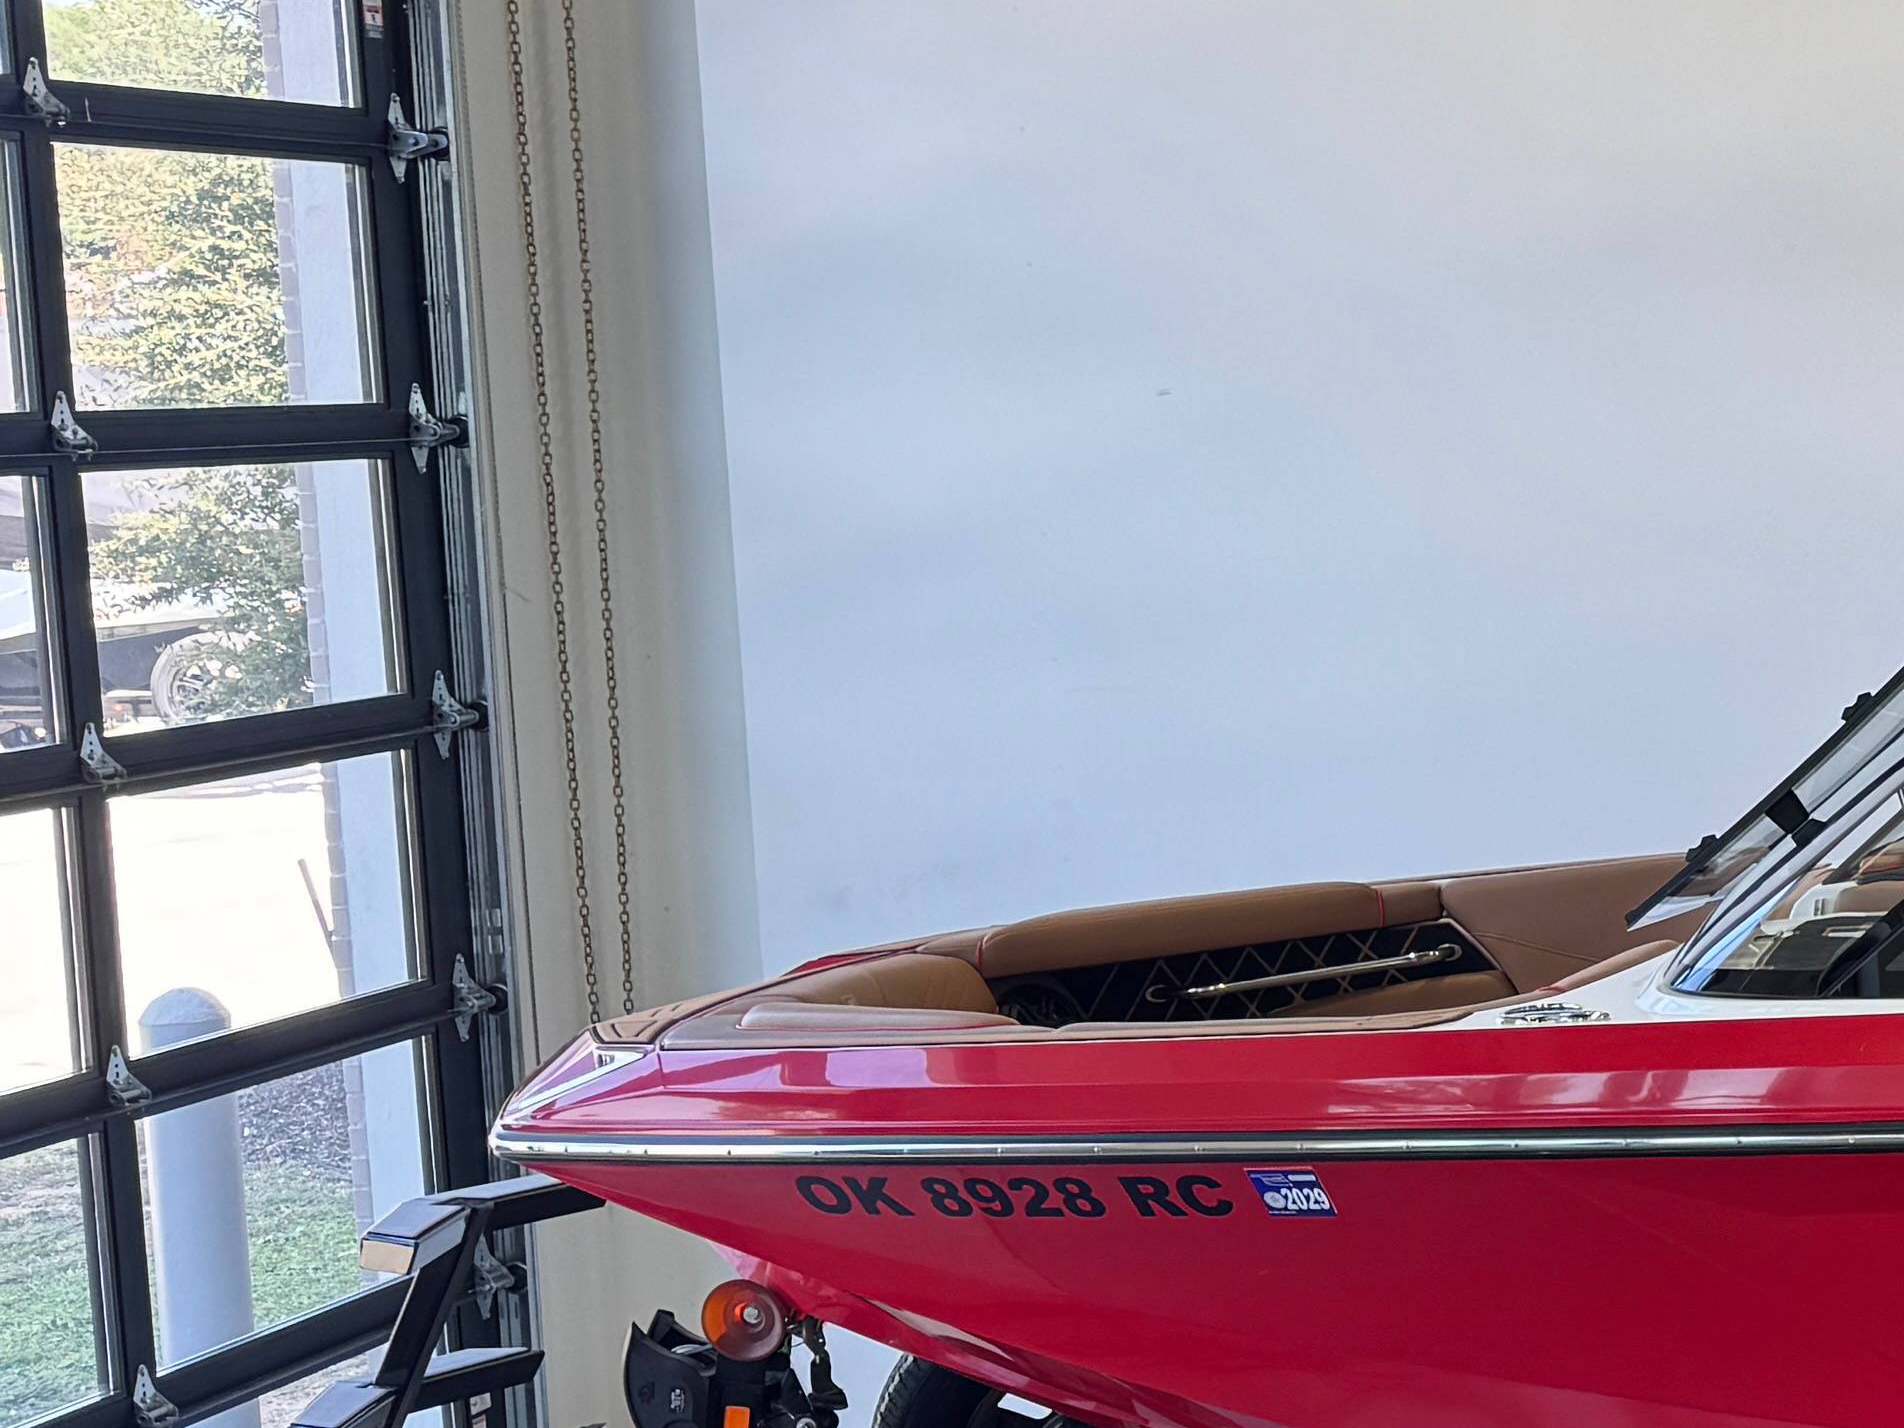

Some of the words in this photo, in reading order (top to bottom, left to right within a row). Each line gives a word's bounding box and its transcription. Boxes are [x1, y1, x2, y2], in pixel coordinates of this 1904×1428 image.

[796, 1175, 911, 1218] OK
[922, 1176, 1107, 1218] 8928
[1119, 1175, 1234, 1217] RC
[1279, 1187, 1331, 1211] 2029
